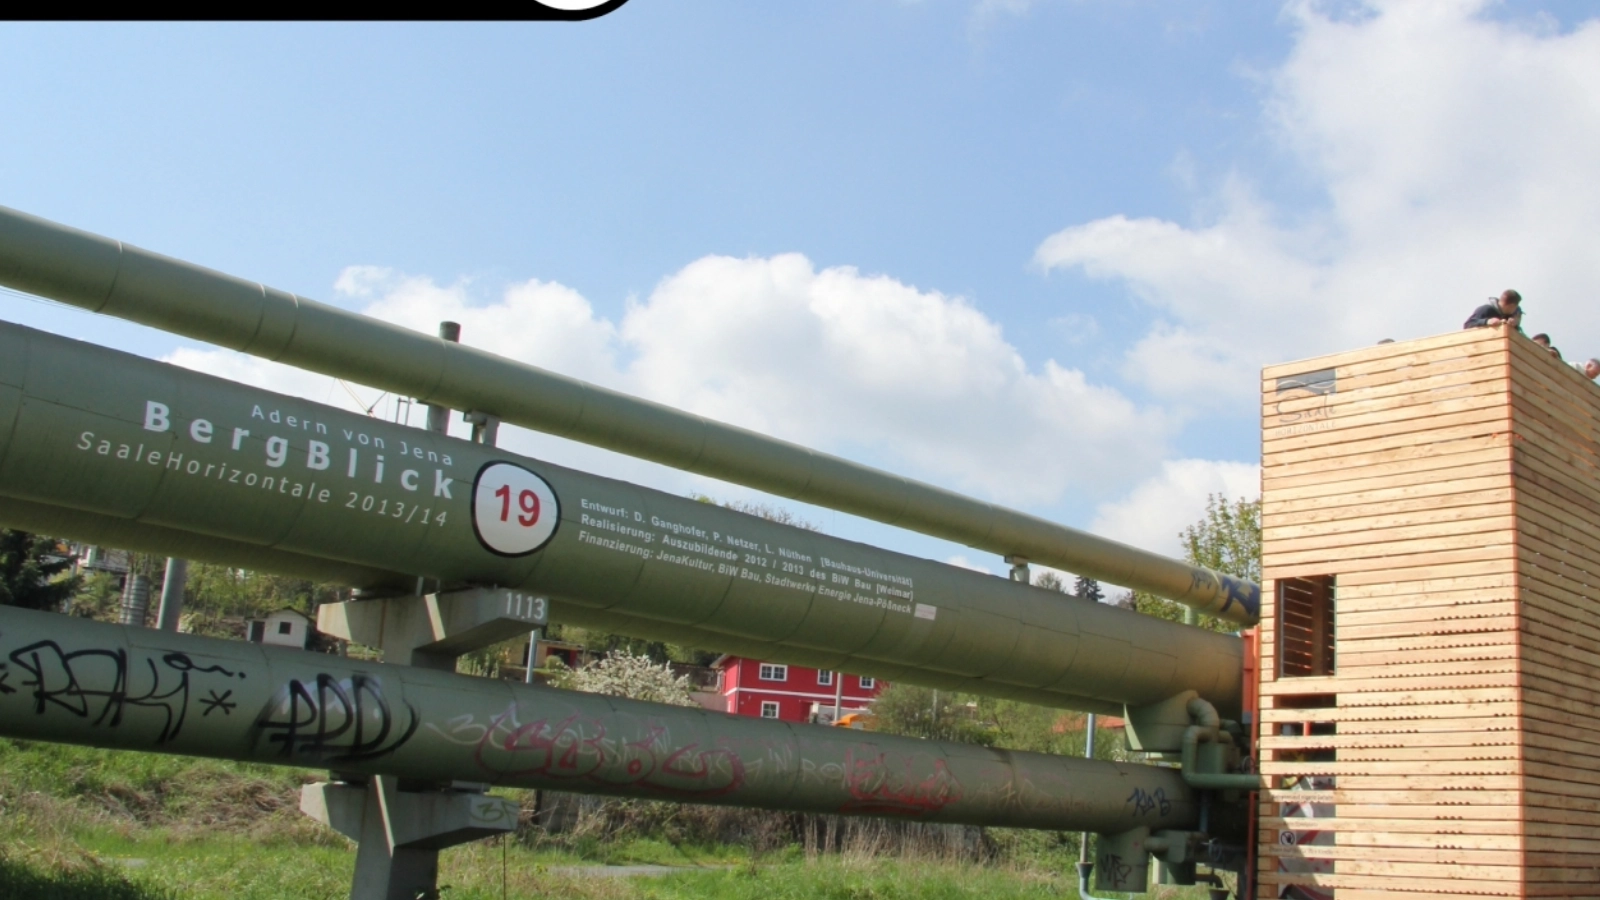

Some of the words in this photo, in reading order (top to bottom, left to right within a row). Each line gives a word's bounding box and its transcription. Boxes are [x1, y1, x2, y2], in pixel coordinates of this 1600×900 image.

[143, 399, 454, 500] BergBlick
[251, 404, 328, 435] Adern
[343, 428, 386, 449] von
[400, 440, 454, 467] Jena
[76, 431, 331, 503] SaaleHorizontale
[345, 491, 448, 527] 2013/14
[494, 484, 541, 527] 19
[580, 498, 629, 519] Entwurf:
[633, 510, 646, 523] D.
[651, 516, 709, 541] Ganghofer,
[712, 530, 723, 543] P.
[726, 535, 762, 553] Netzer,
[764, 543, 775, 555] L.
[778, 547, 812, 563] Nüthen
[581, 513, 656, 542] Realisierung:
[661, 534, 738, 561] Auszubildende
[744, 553, 768, 567] 2012
[772, 559, 777, 569] /
[782, 561, 804, 576] 2013
[809, 568, 827, 581] des
[831, 572, 850, 586] BiW
[854, 578, 872, 591] Bau
[505, 591, 546, 620] 11.13
[578, 530, 655, 560] Finanzierung:
[656, 550, 715, 573] JenaKultur,
[718, 563, 739, 577] BiW
[740, 568, 762, 583] Bau,
[764, 572, 817, 594] Stadtwerke
[818, 585, 852, 601] Energie
[853, 592, 912, 614] Jena-Pößneck
